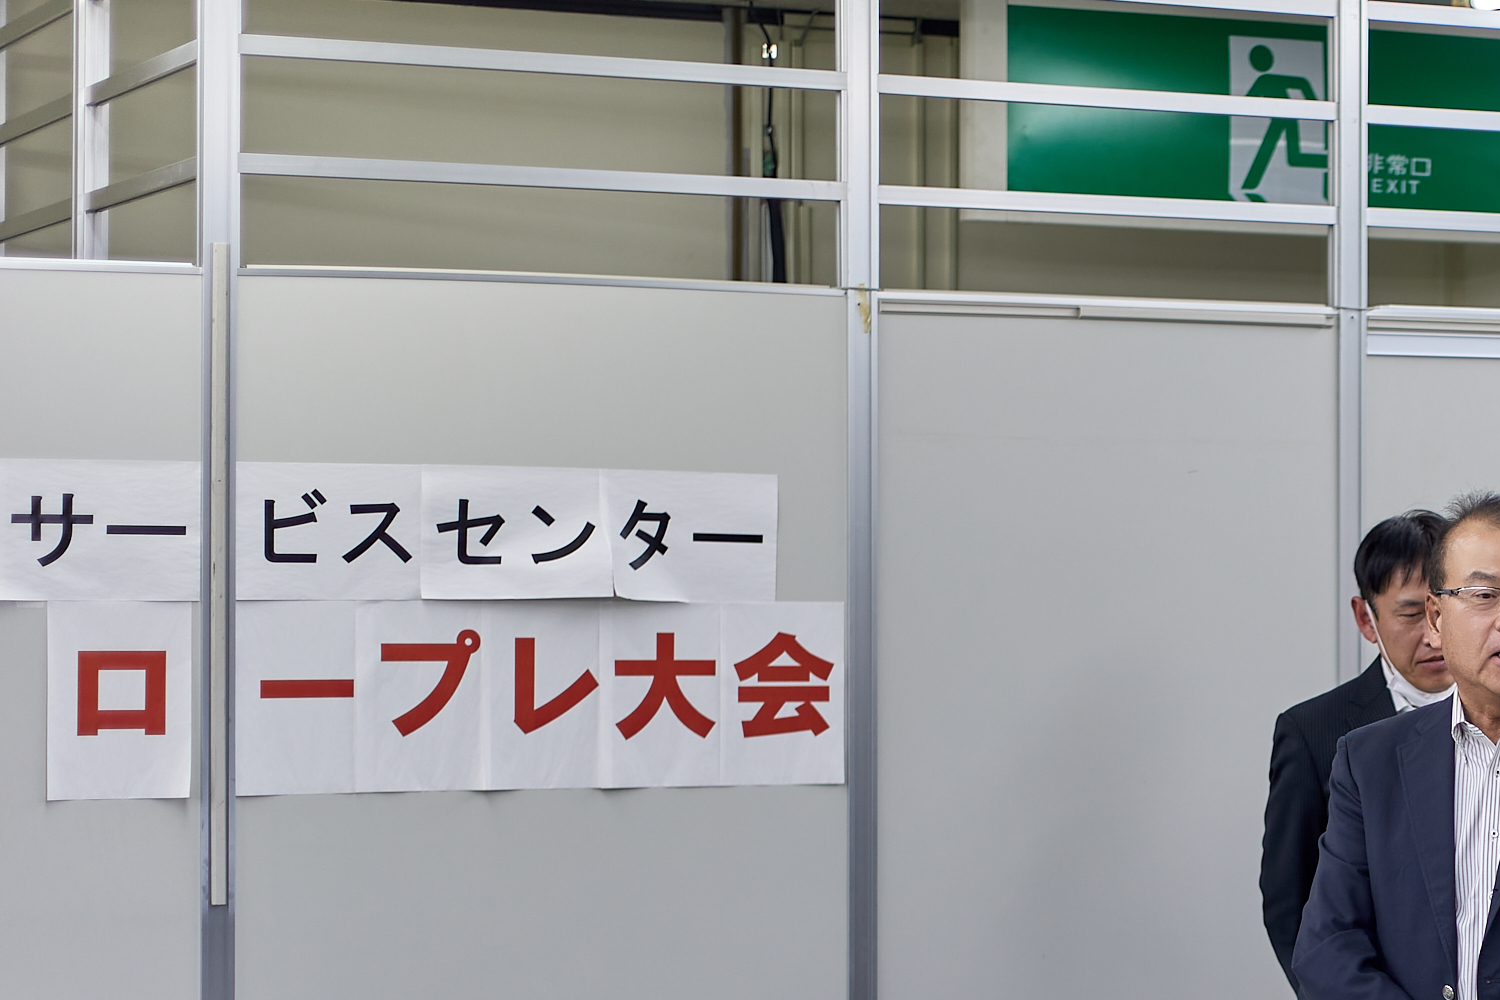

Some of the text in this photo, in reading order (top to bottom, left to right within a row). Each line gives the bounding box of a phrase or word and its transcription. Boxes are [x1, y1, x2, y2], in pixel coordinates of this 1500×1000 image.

[1368, 153, 1431, 176] 非常口
[1372, 179, 1420, 194] EXIT
[11, 488, 764, 571] サービスセンター
[77, 629, 834, 740] ロープレ大会
